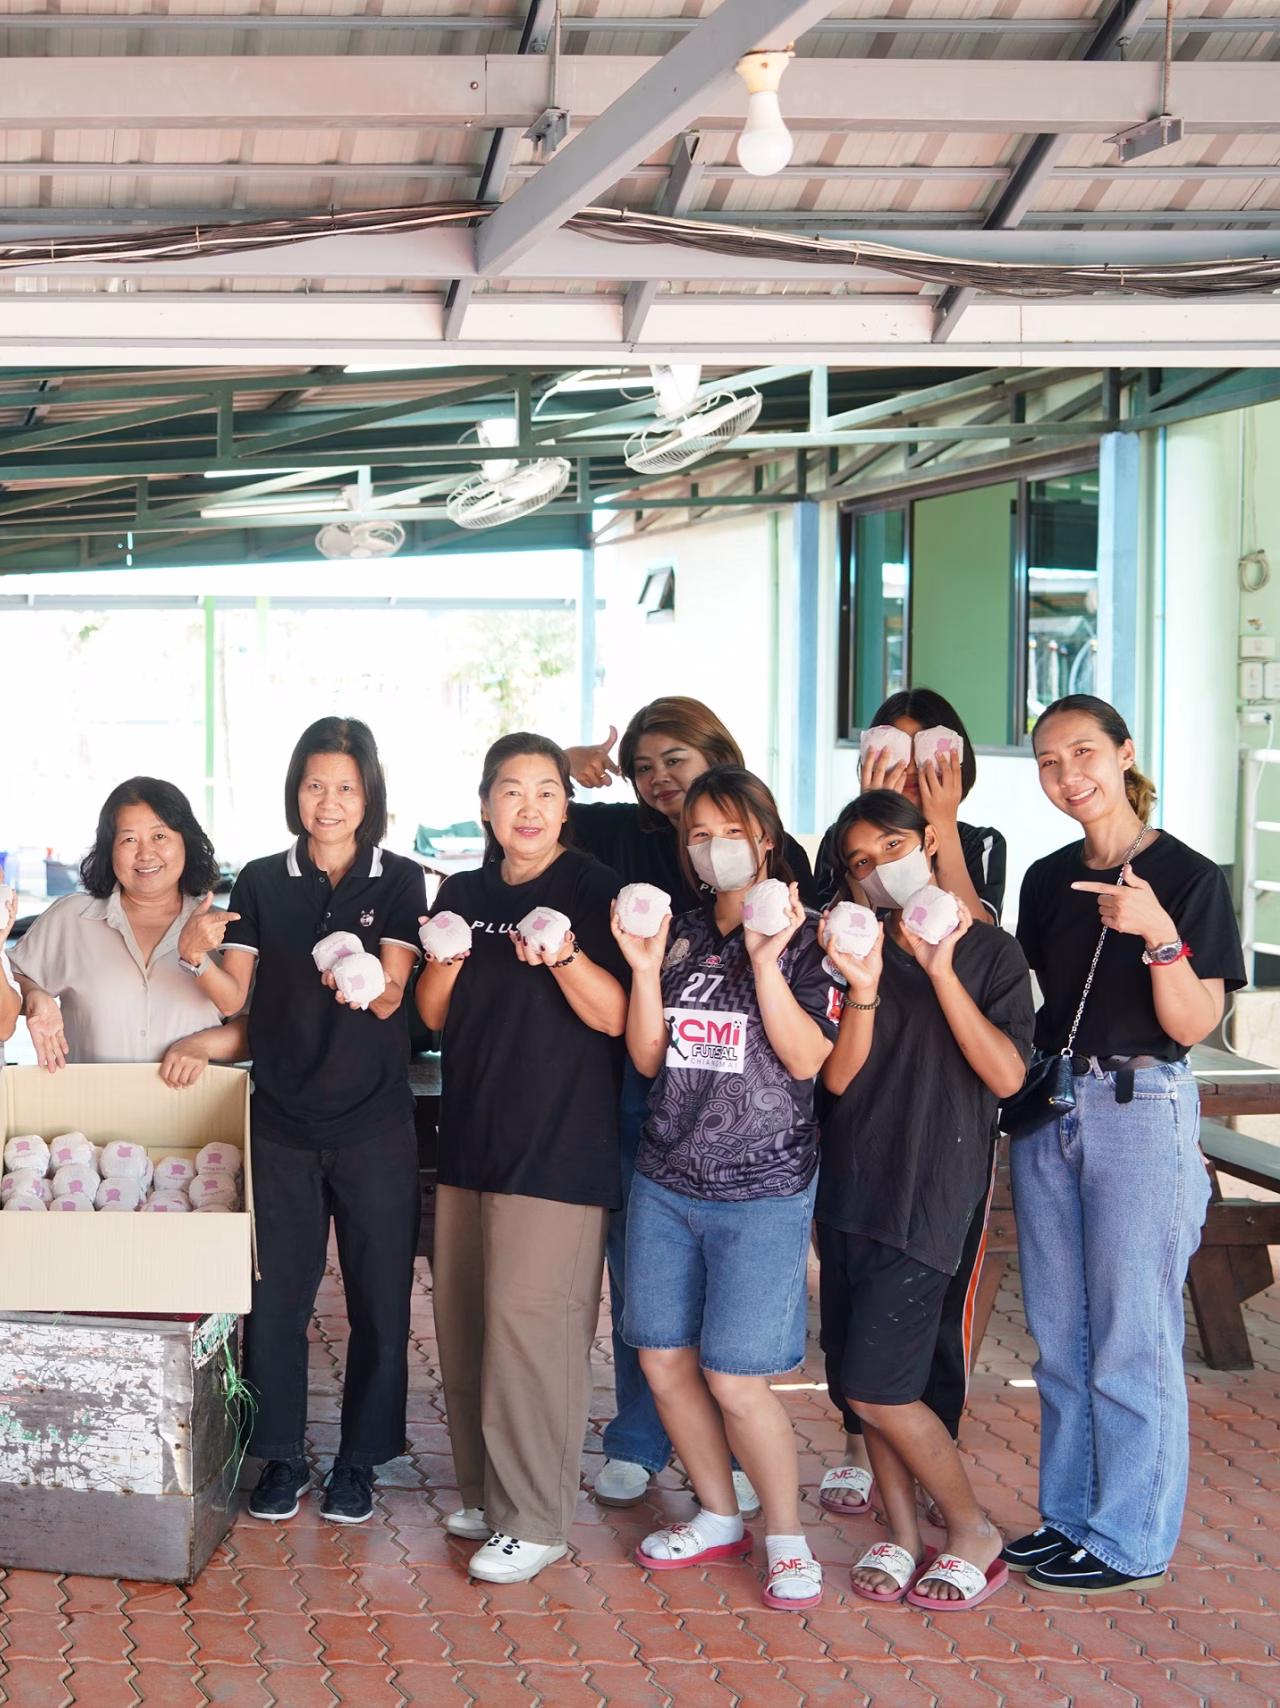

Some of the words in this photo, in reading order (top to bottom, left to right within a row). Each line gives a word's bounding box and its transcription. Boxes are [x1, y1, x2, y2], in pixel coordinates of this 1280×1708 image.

[700, 883, 717, 894] PL
[470, 920, 519, 934] PLU
[680, 972, 725, 1003] 27
[691, 1043, 738, 1061] FUTSAL
